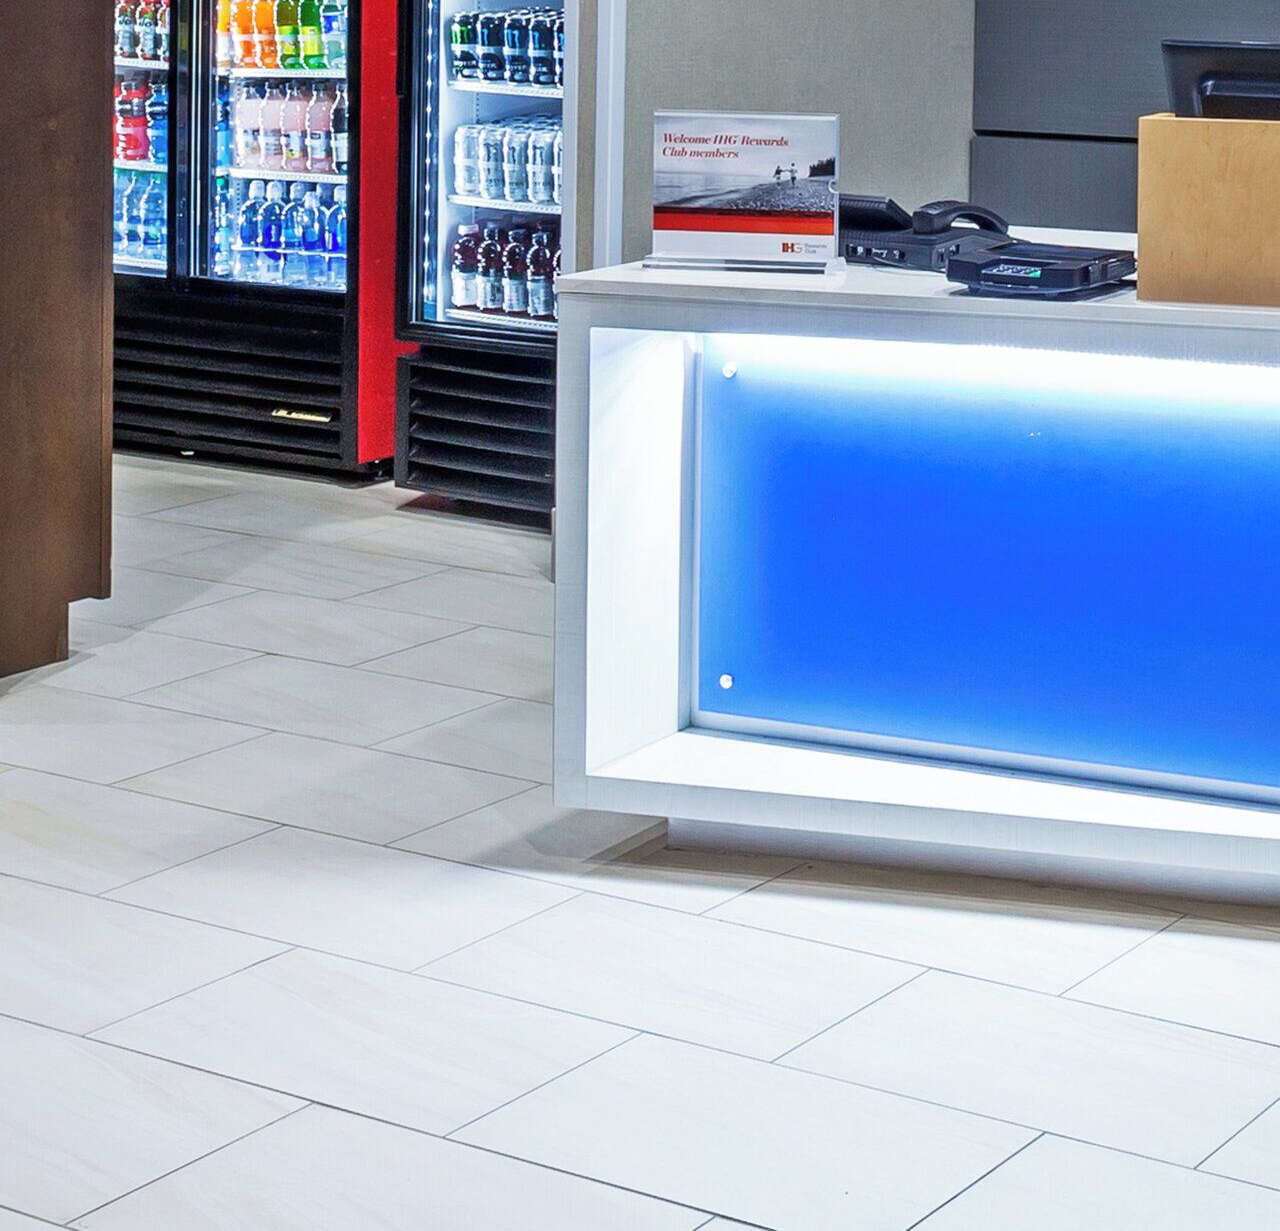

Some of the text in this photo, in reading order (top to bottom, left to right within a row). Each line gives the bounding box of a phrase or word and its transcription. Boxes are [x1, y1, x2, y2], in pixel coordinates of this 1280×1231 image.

[663, 133, 790, 147] Welcome IHG Rewards
[662, 146, 739, 159] Club members
[782, 242, 803, 254] IHG
